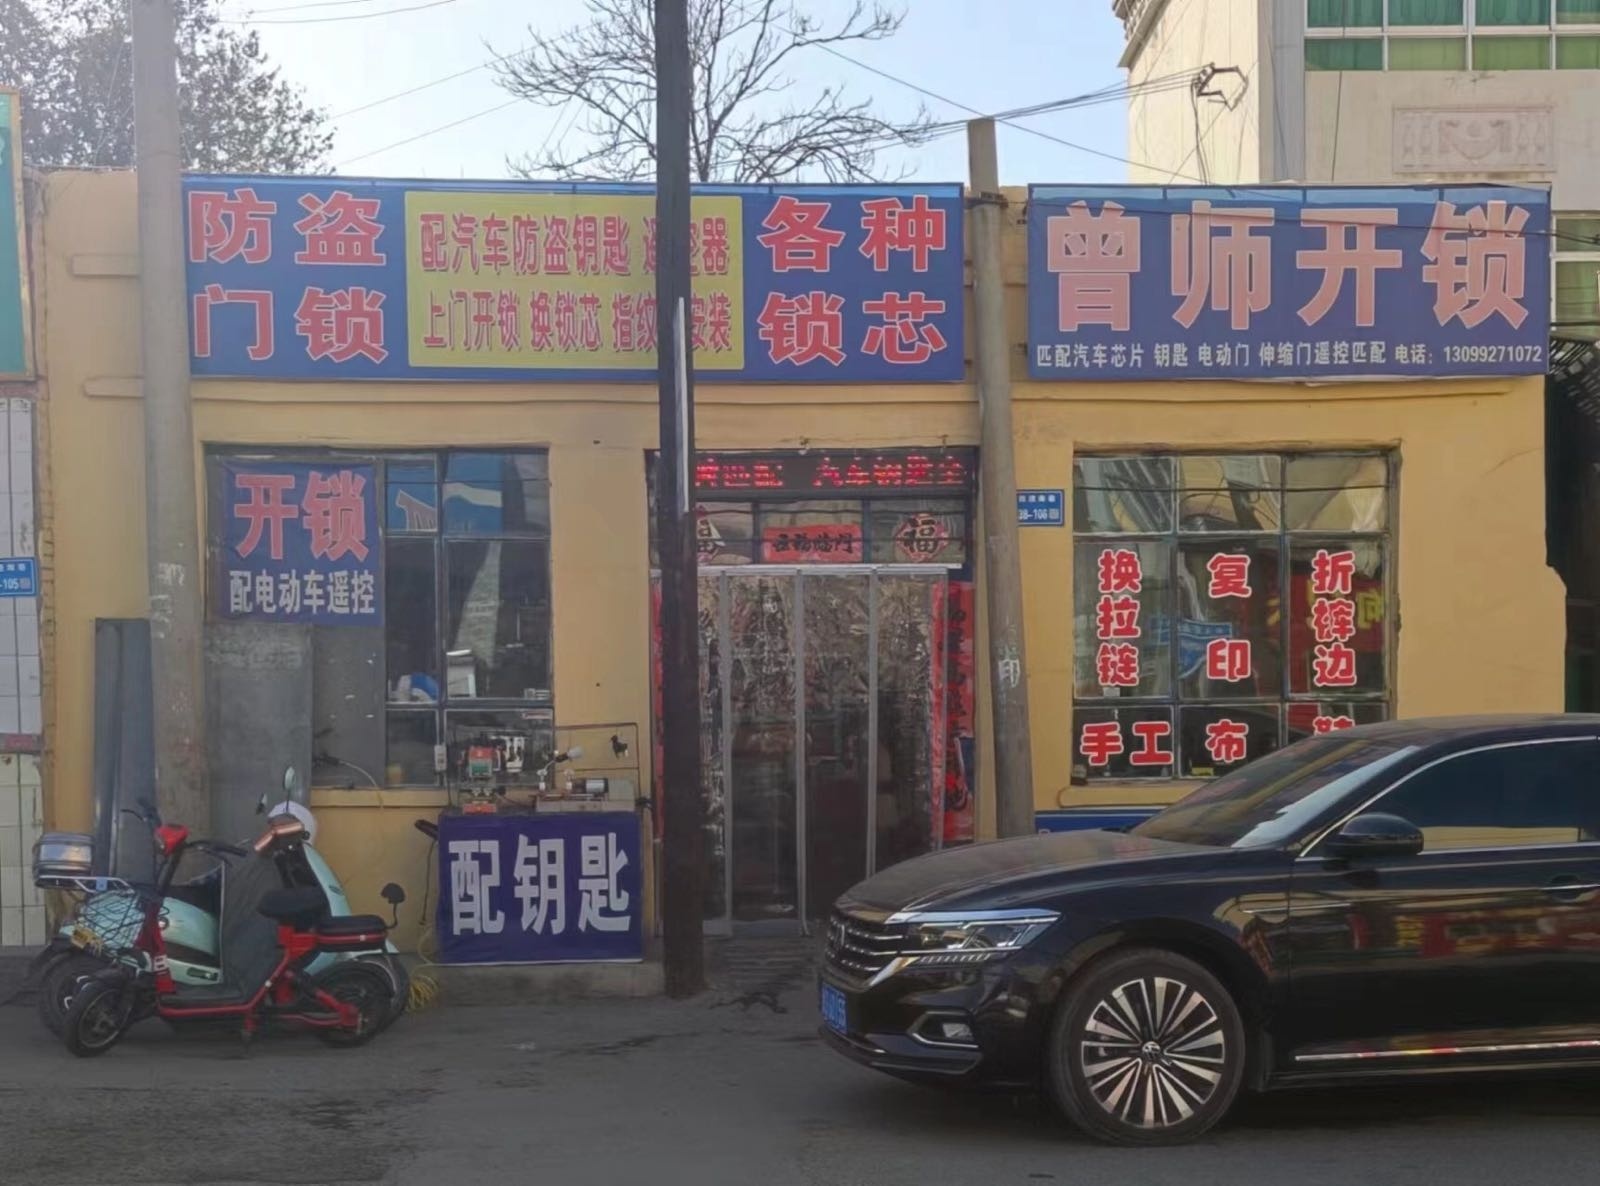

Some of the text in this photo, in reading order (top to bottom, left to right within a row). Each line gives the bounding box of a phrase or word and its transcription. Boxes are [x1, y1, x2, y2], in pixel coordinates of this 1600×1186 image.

[189, 188, 386, 266] 防盗
[420, 212, 630, 276] 配汽车防盗钥匙
[757, 195, 946, 272] 各种
[1046, 200, 1531, 332] 曾师开锁
[193, 284, 388, 364] 门锁
[423, 290, 521, 352] 上门开锁
[530, 290, 603, 352] 换锁芯
[757, 291, 947, 366] 锁芯
[1036, 343, 1145, 368] 匹配汽车芯片
[1153, 342, 1189, 368] 钥匙
[1198, 342, 1250, 366] 电动门
[1258, 340, 1386, 367] 伸缩门遥控匹配
[1443, 344, 1542, 363] 13099271072
[234, 470, 369, 562] 开锁
[229, 569, 375, 614] 配电动车遥控
[1096, 549, 1141, 686] 换拉链
[1206, 553, 1252, 682] 复印
[1311, 550, 1357, 687] 折裤边
[448, 832, 632, 936] 配钥匙
